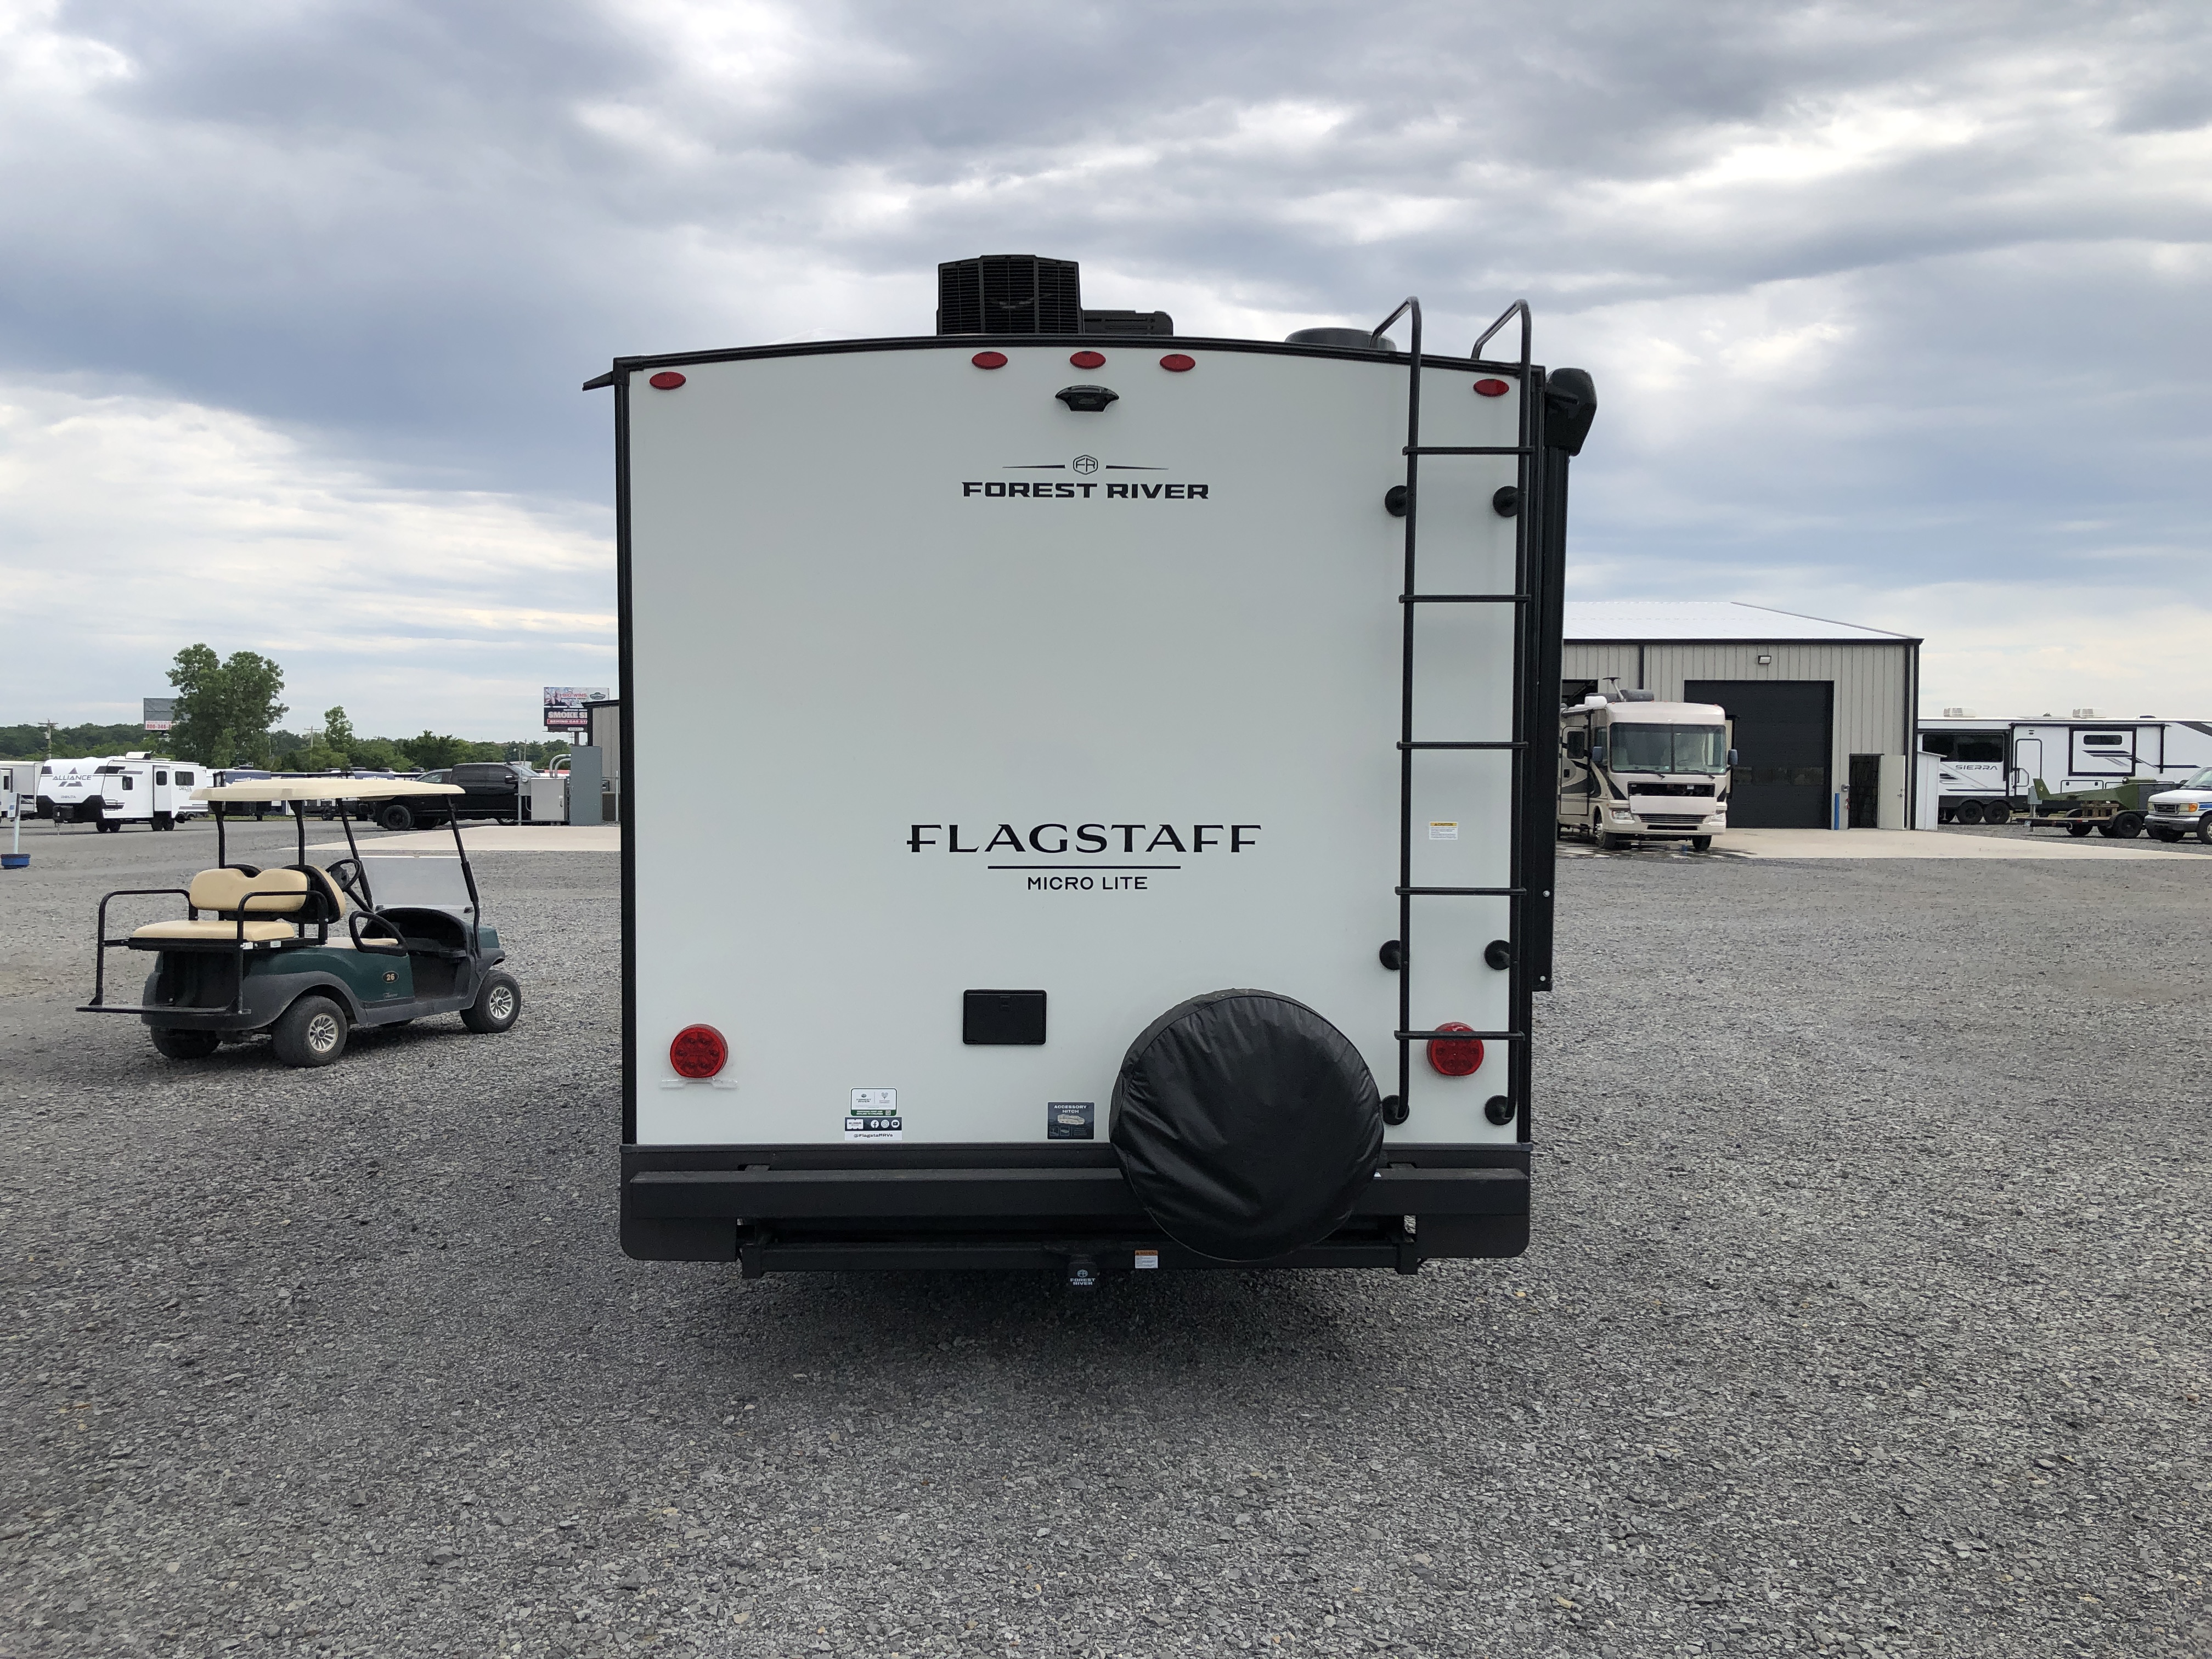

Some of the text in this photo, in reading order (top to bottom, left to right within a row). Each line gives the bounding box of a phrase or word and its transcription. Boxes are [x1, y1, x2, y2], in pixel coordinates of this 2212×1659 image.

[961, 482, 1209, 499] FOREST RIVER
[906, 823, 1262, 854] FLAGSTAFF
[1028, 876, 1148, 890] MICRO LITE
